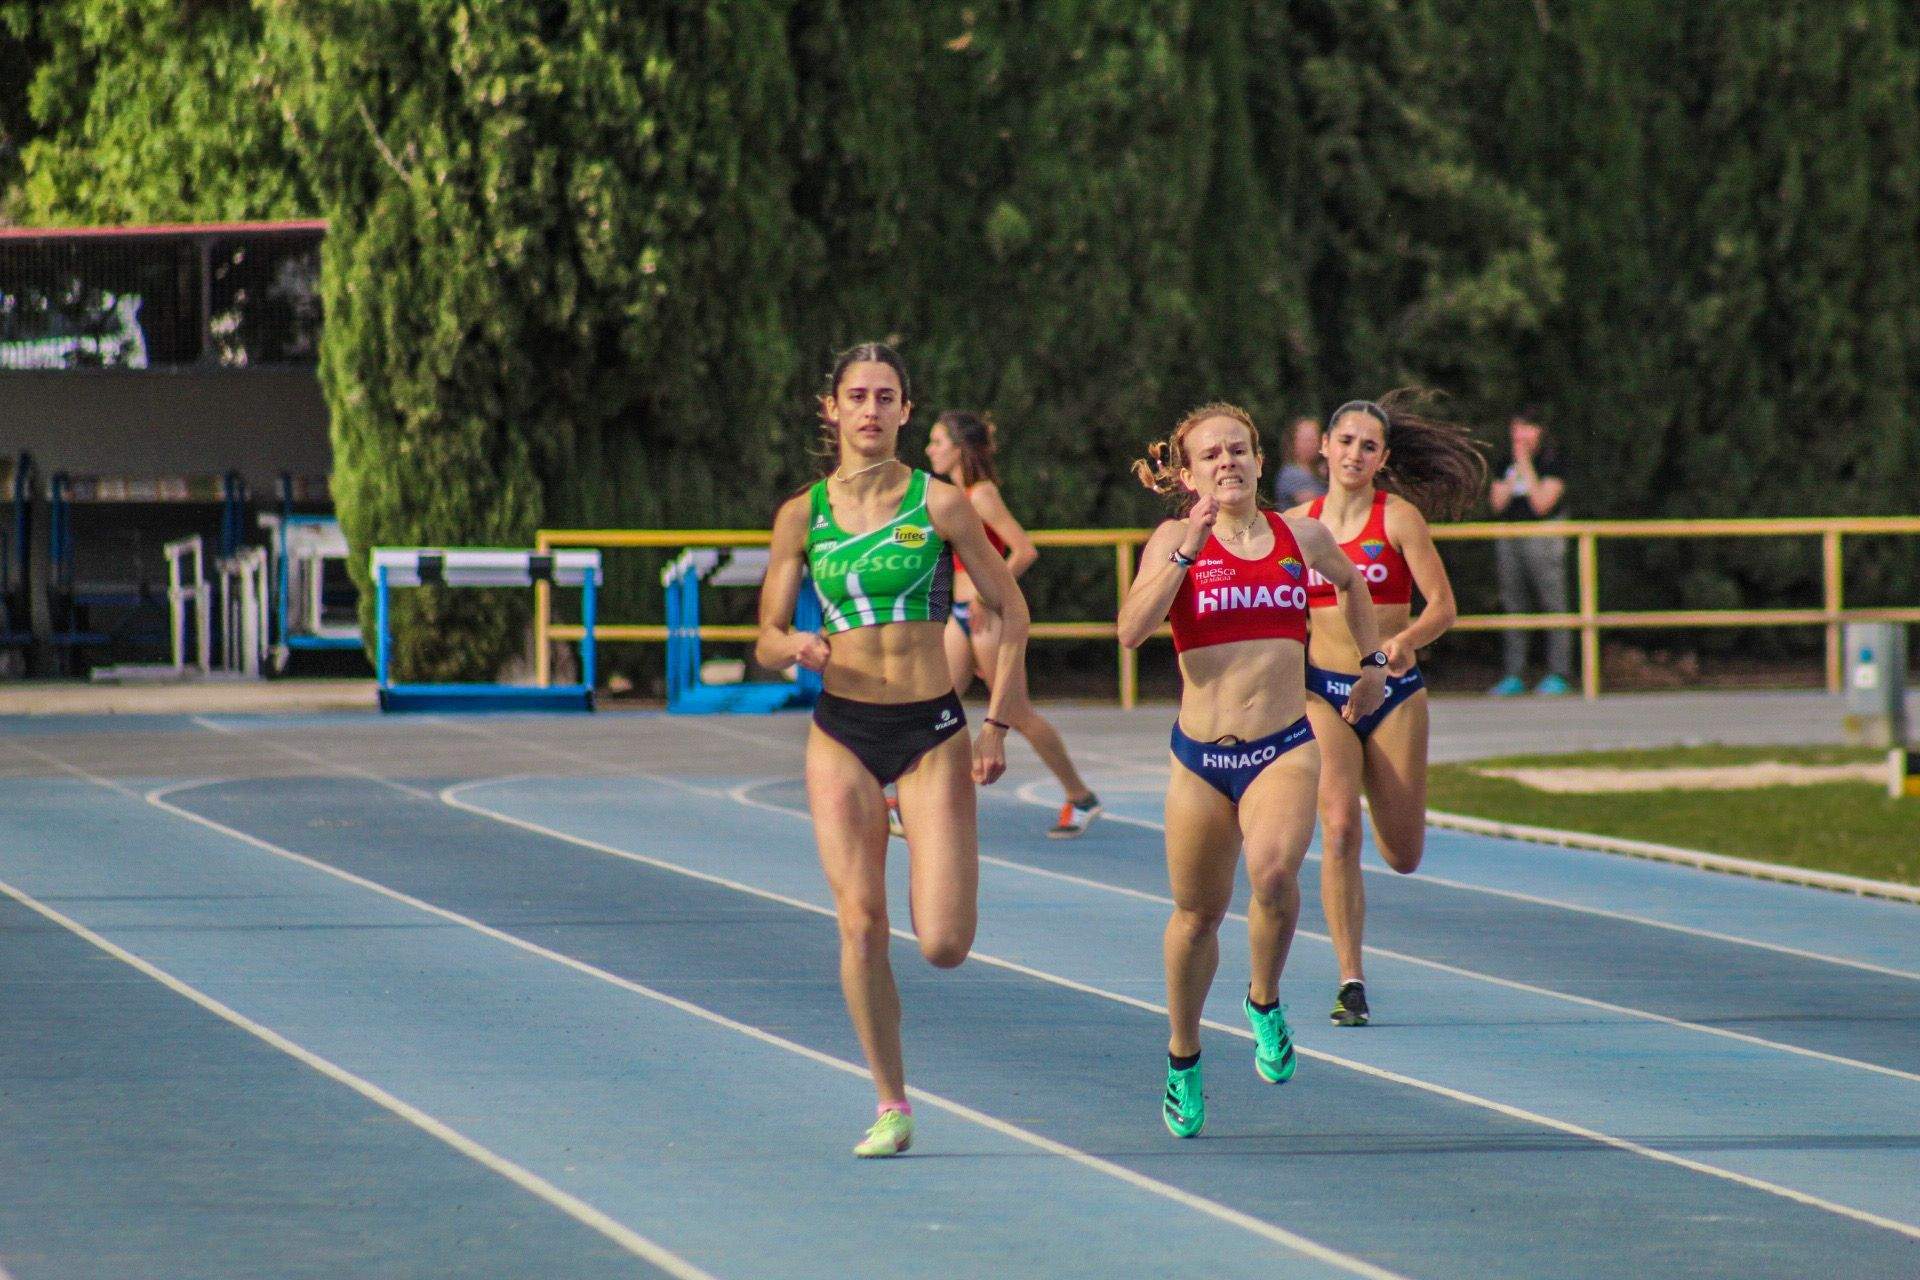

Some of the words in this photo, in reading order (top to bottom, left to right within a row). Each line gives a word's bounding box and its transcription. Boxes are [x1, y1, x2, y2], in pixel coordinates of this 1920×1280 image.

[812, 555, 922, 579] Huesca
[1198, 585, 1306, 613] HINACO
[1203, 745, 1276, 769] HINACO
